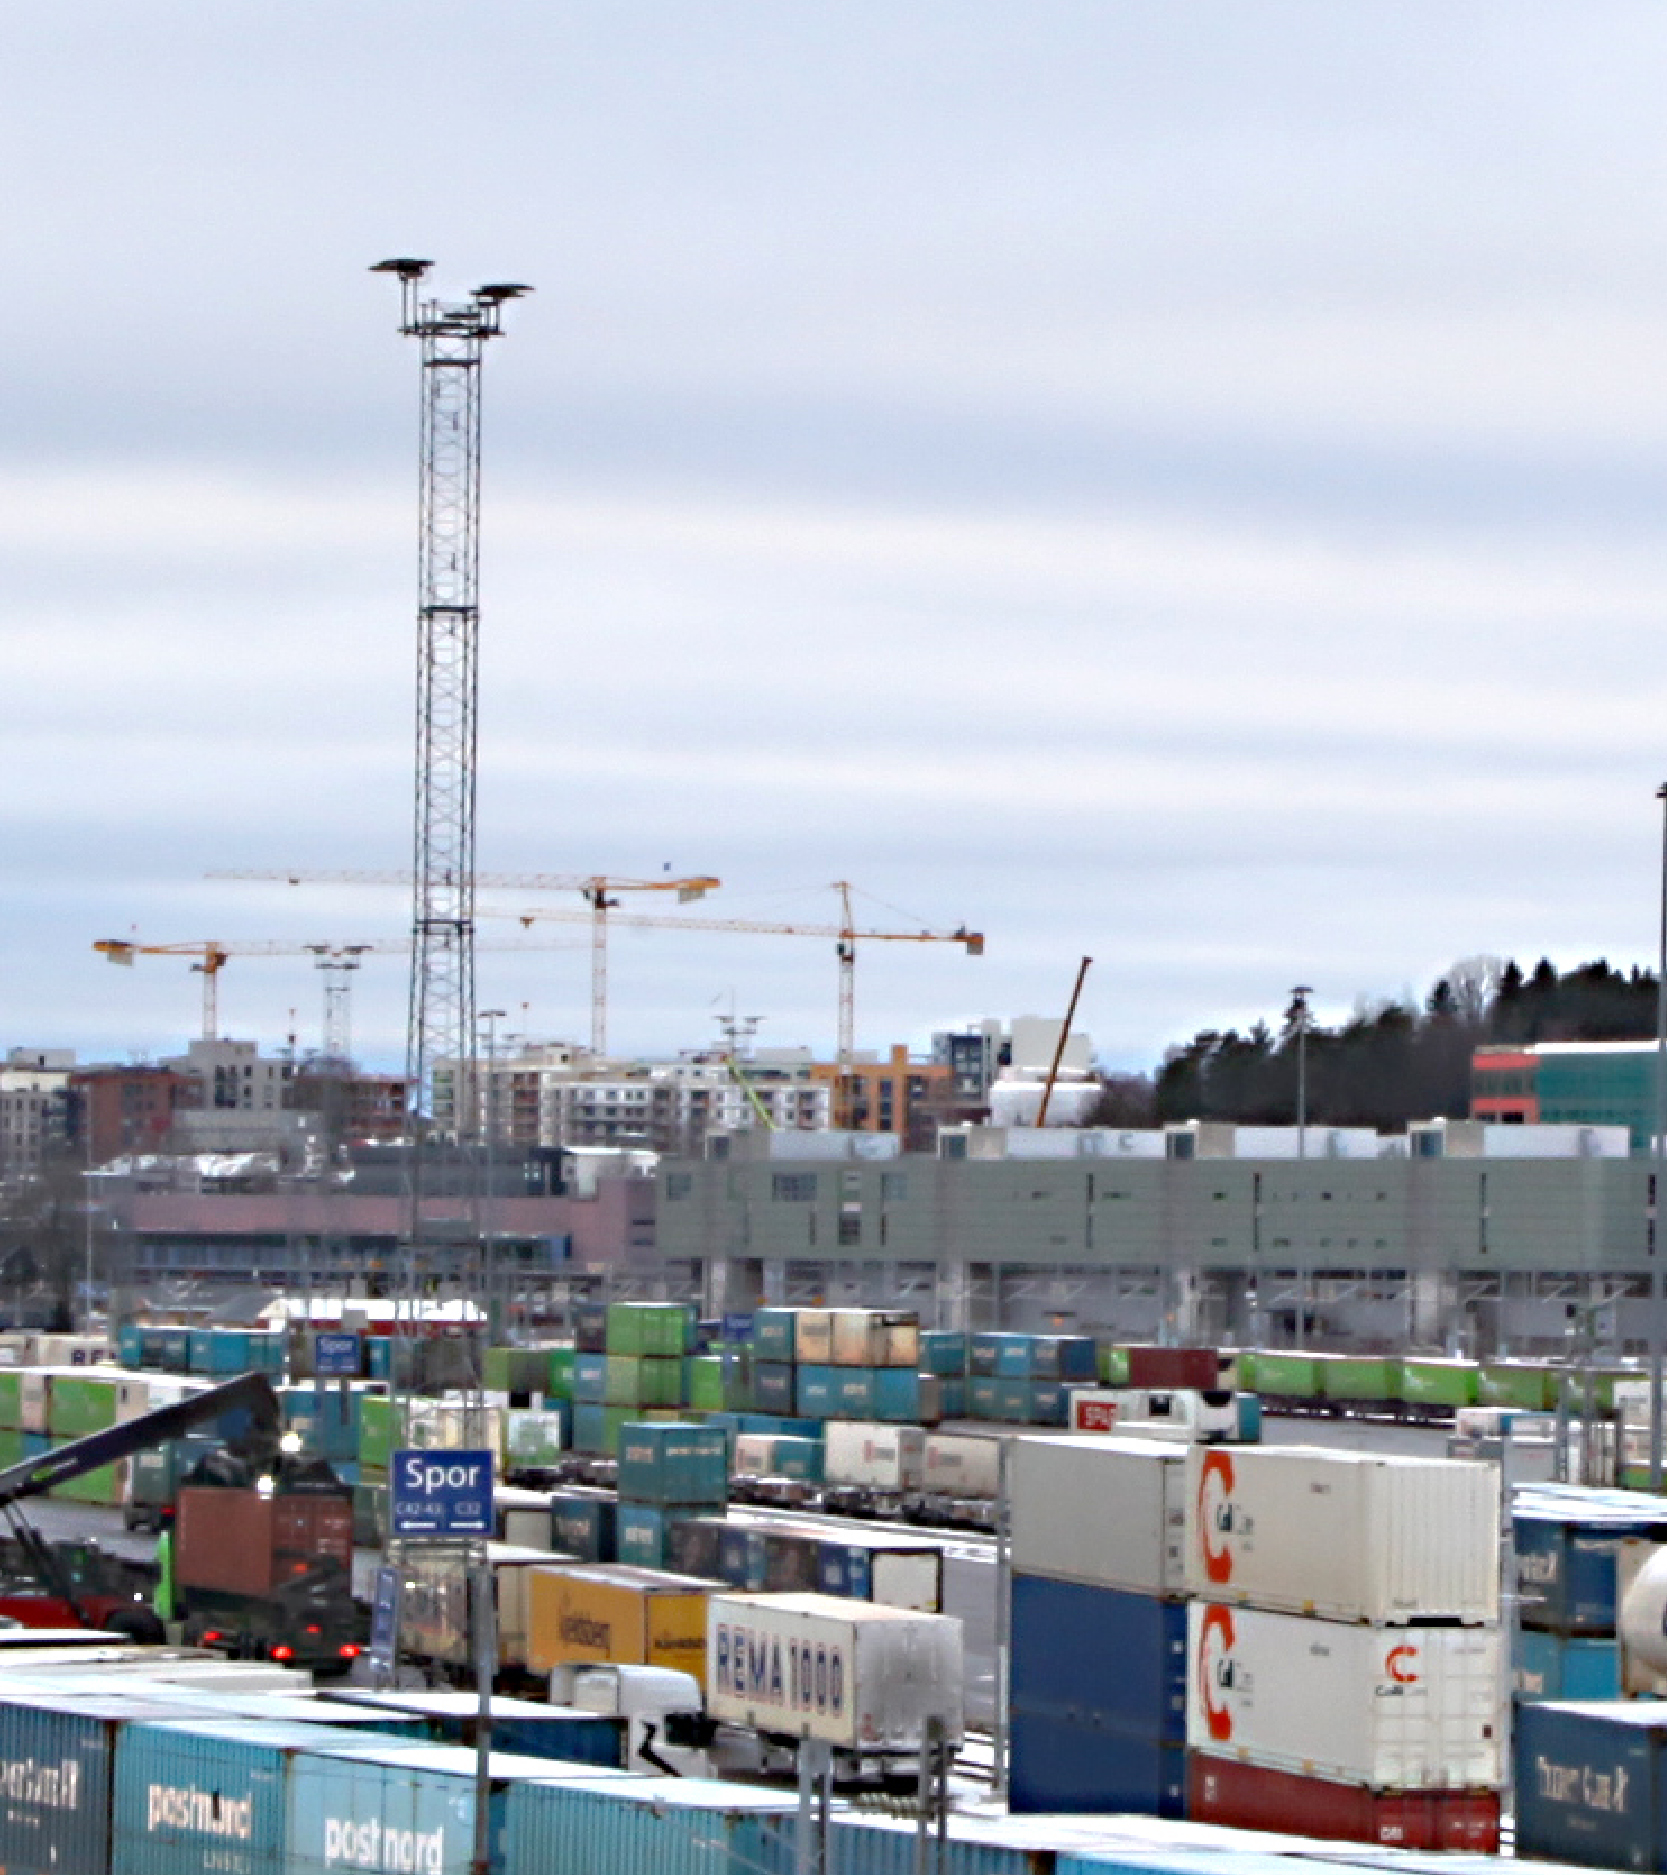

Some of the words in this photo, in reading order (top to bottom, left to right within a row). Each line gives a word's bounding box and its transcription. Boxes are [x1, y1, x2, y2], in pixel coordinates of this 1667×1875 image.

[406, 1458, 479, 1494] Spor
[716, 1623, 784, 1704] REMA
[790, 1637, 842, 1718] 1000
[324, 1818, 443, 1875] postnord
